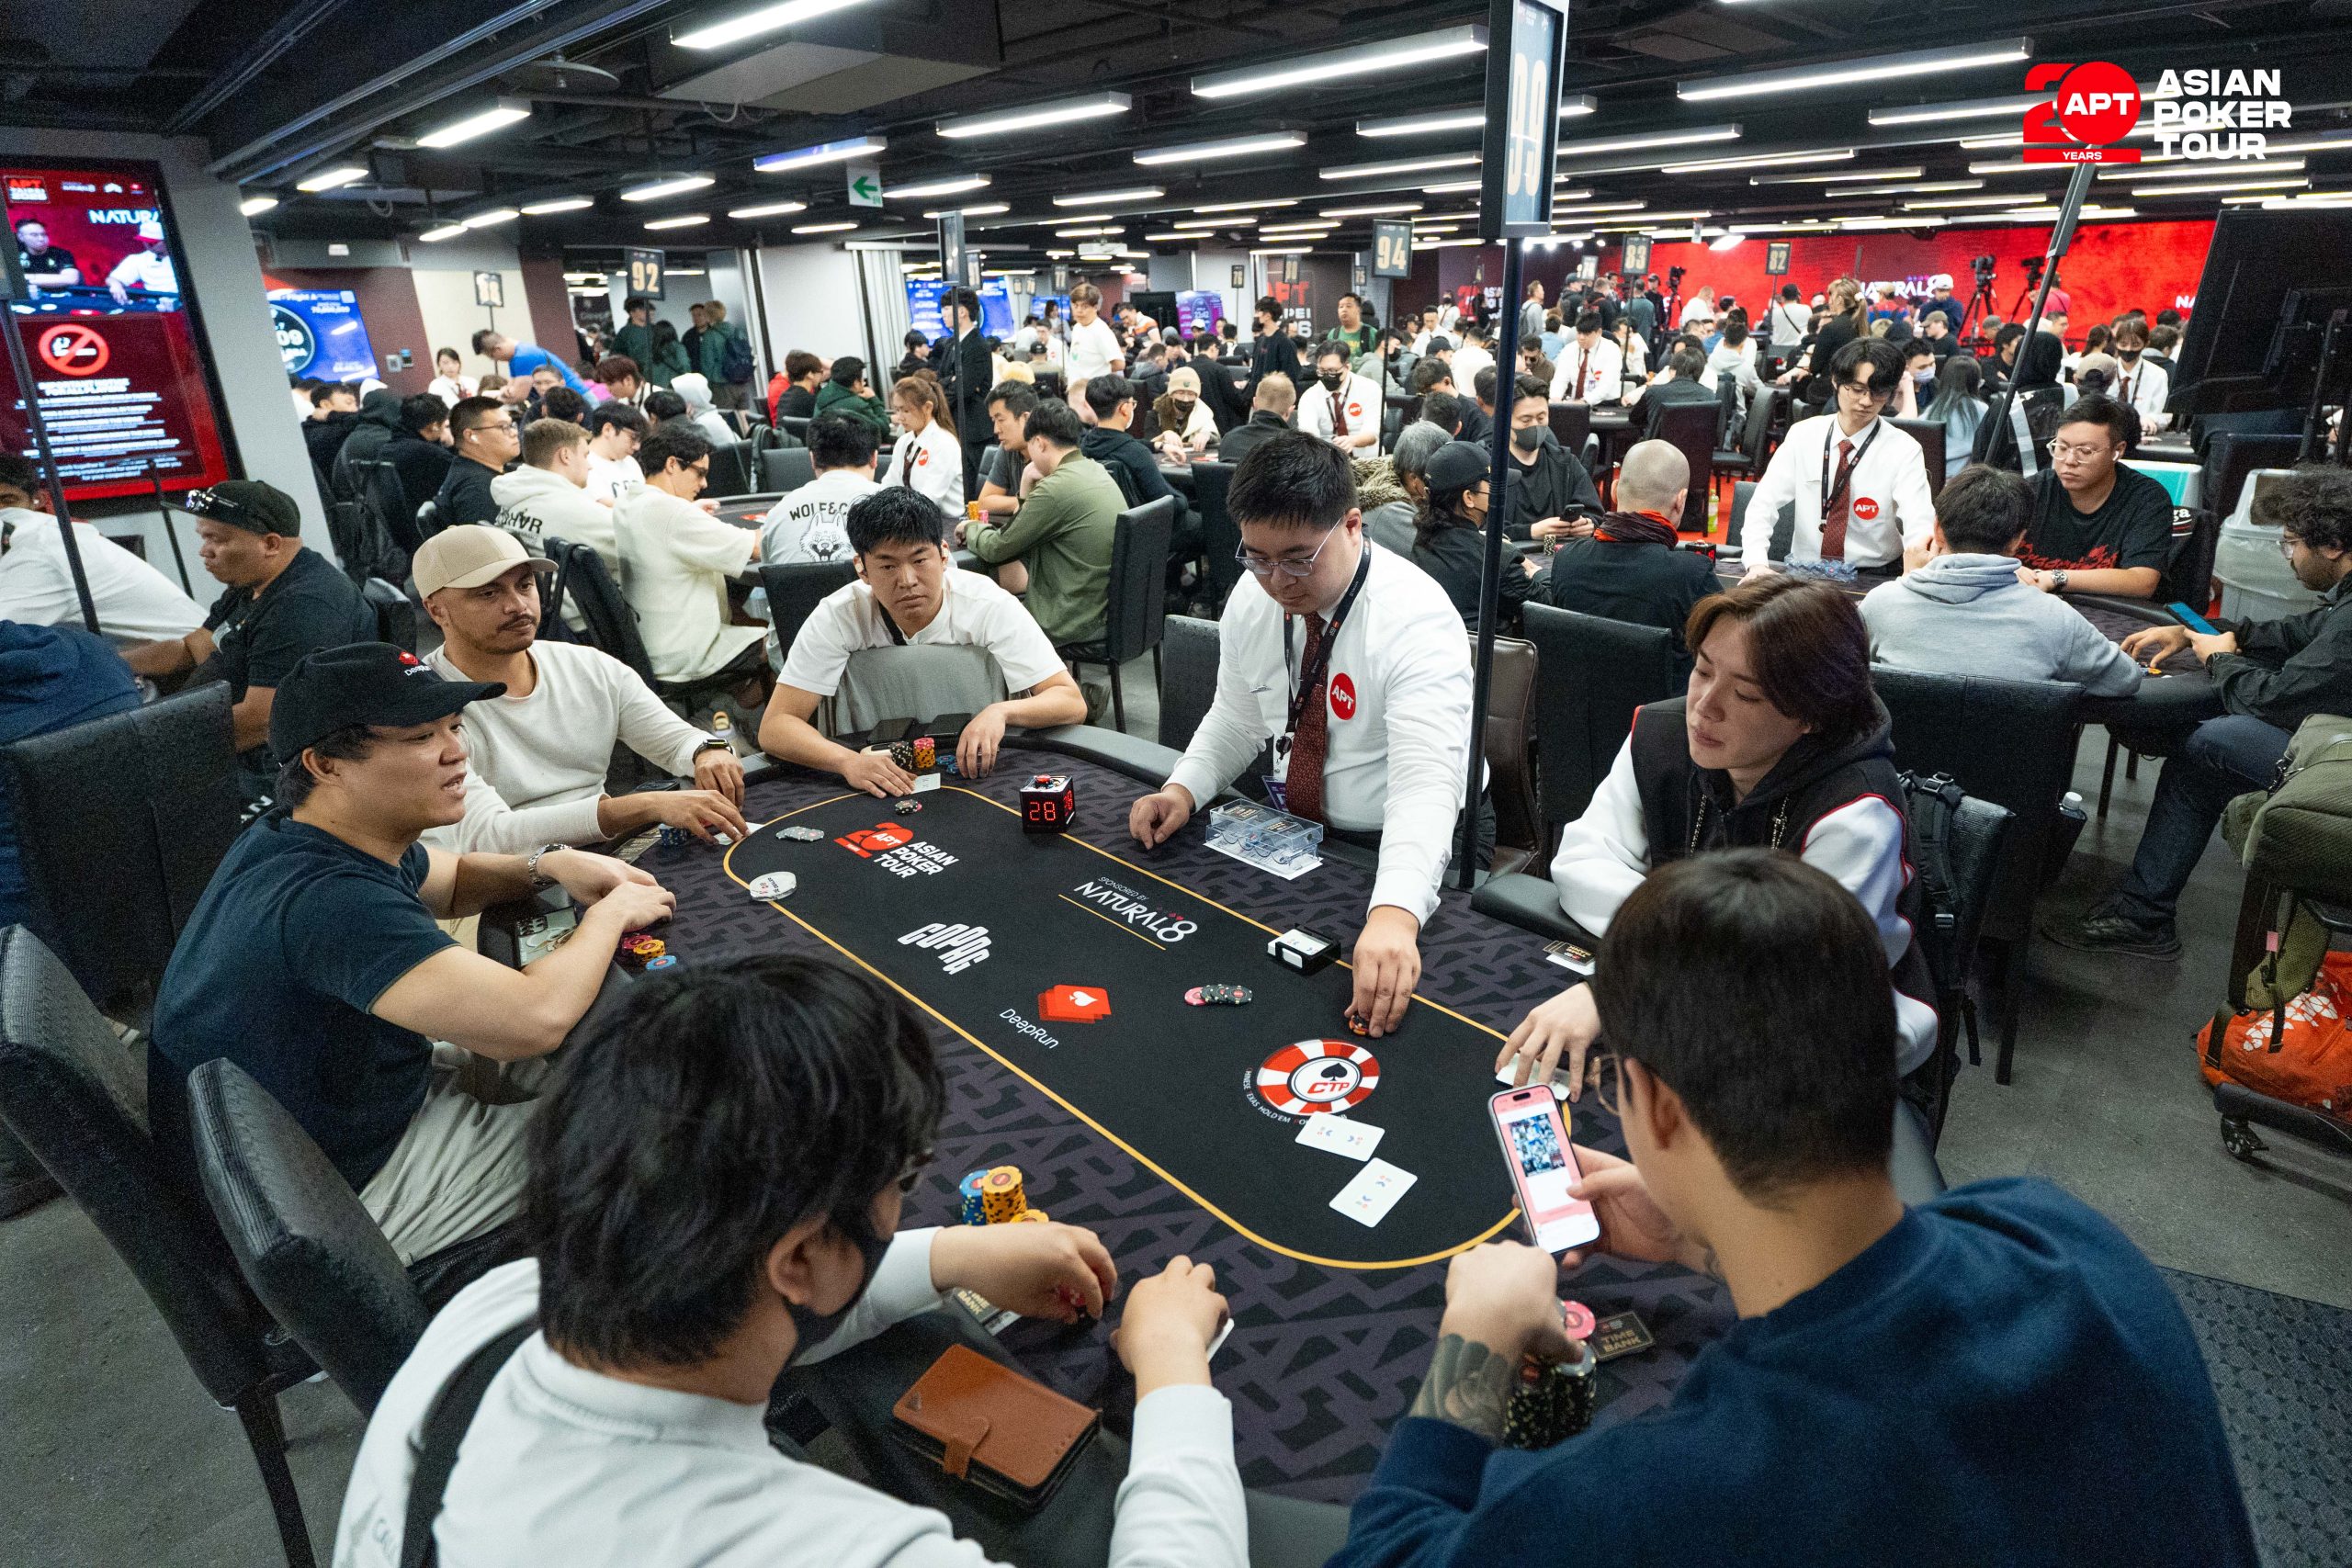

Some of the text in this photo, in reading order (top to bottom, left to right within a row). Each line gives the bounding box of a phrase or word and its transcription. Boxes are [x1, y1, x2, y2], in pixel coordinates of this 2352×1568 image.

[1376, 235, 1407, 270] 94
[1624, 244, 1647, 269] 83
[1769, 250, 1788, 270] 82
[631, 261, 660, 293] 92
[1854, 503, 1877, 513] APT
[1331, 684, 1355, 710] APT
[1029, 801, 1057, 821] 28
[872, 832, 903, 846] APT
[873, 853, 918, 878] TOUR
[889, 846, 944, 875] POKER
[908, 840, 959, 866] ASIAN
[1098, 876, 1139, 897] SPONSORED
[1073, 881, 1198, 942] NATURAL8
[897, 922, 992, 976] COPAG
[1000, 1008, 1059, 1050] DeepRun
[1243, 1066, 1254, 1091] CHINESE
[1258, 1105, 1292, 1123] HOLD'EM
[1306, 1081, 1351, 1095] CTP
[957, 1290, 984, 1315] BANK
[967, 1290, 991, 1309] IME
[1600, 1329, 1634, 1344] TIME
[1603, 1337, 1642, 1353] BANK
